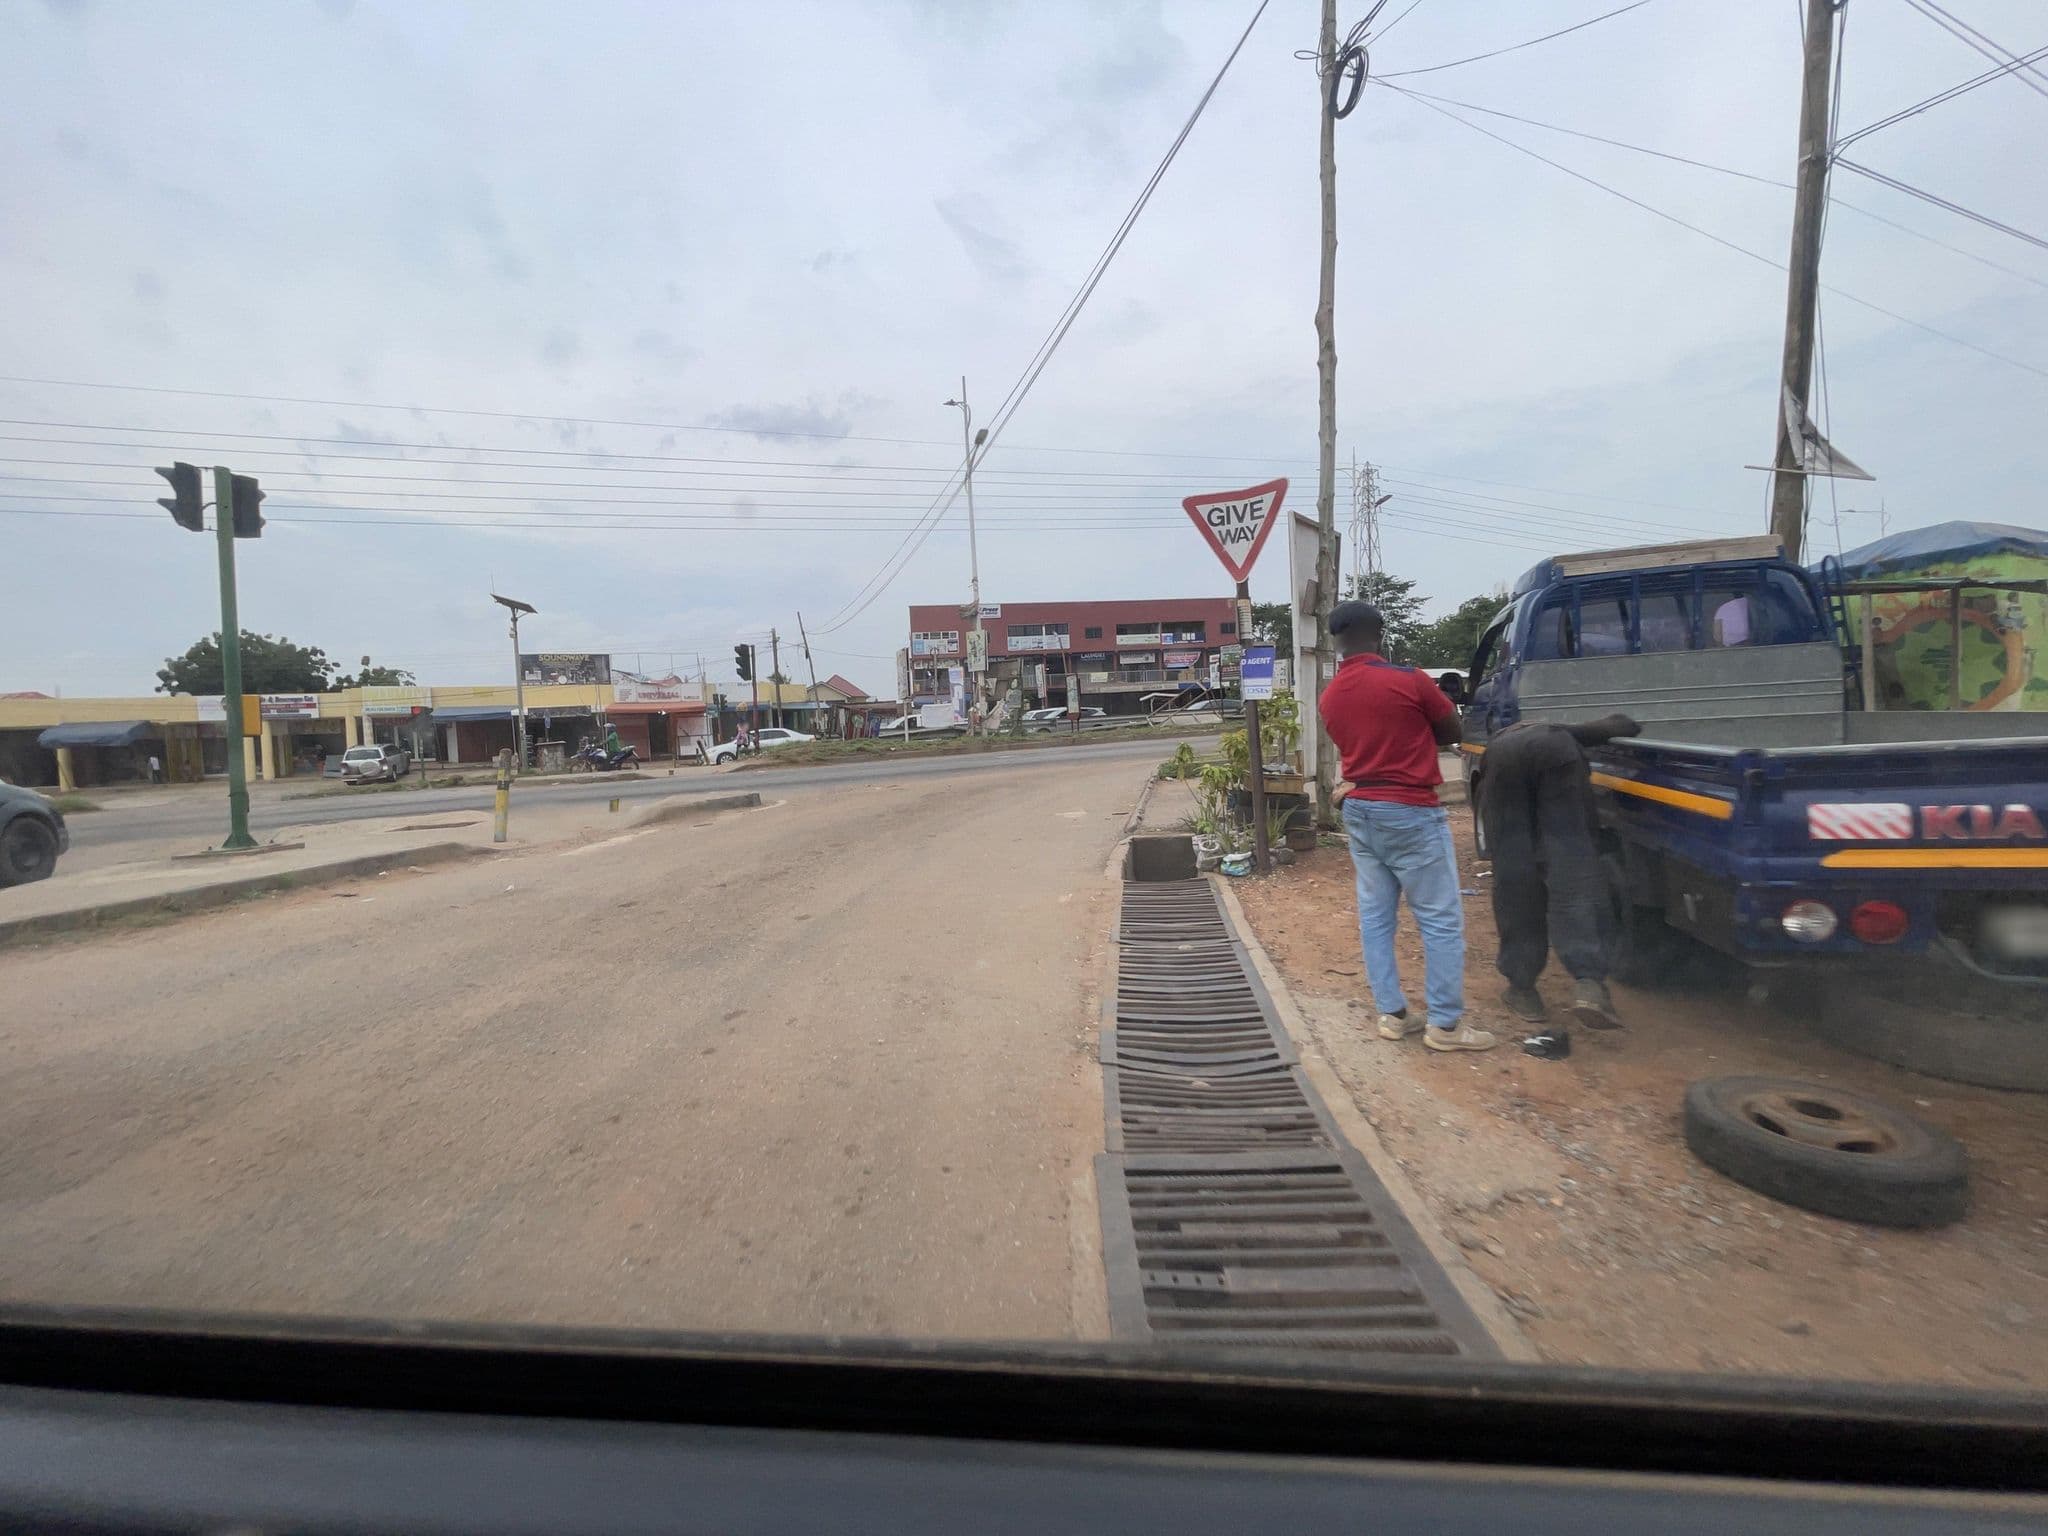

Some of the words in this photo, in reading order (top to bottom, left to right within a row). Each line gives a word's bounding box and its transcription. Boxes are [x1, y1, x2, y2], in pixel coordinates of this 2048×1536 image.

[1207, 499, 1264, 527] GIVE
[1218, 523, 1258, 545] WAY
[538, 654, 590, 662] SOUNDWAVE
[1247, 657, 1271, 665] AGENT
[1920, 804, 2047, 839] KIA
